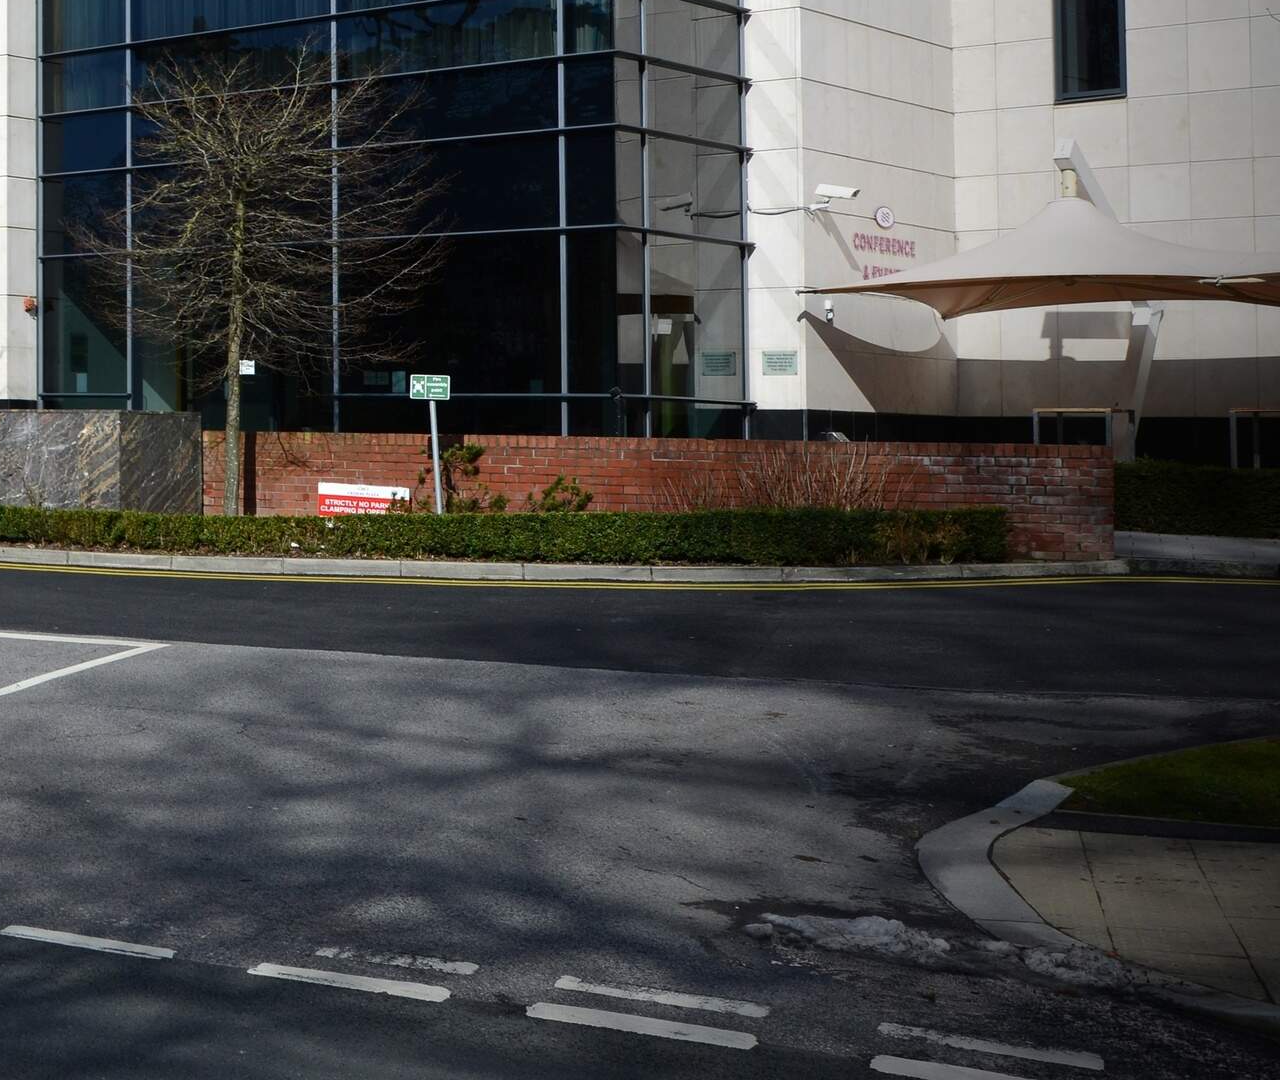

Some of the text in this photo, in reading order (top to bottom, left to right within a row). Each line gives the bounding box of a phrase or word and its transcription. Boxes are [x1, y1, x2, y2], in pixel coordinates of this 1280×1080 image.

[853, 232, 916, 258] CONFERENCE
[325, 499, 358, 507] STRICTLY
[320, 506, 356, 514] CLAMPING
